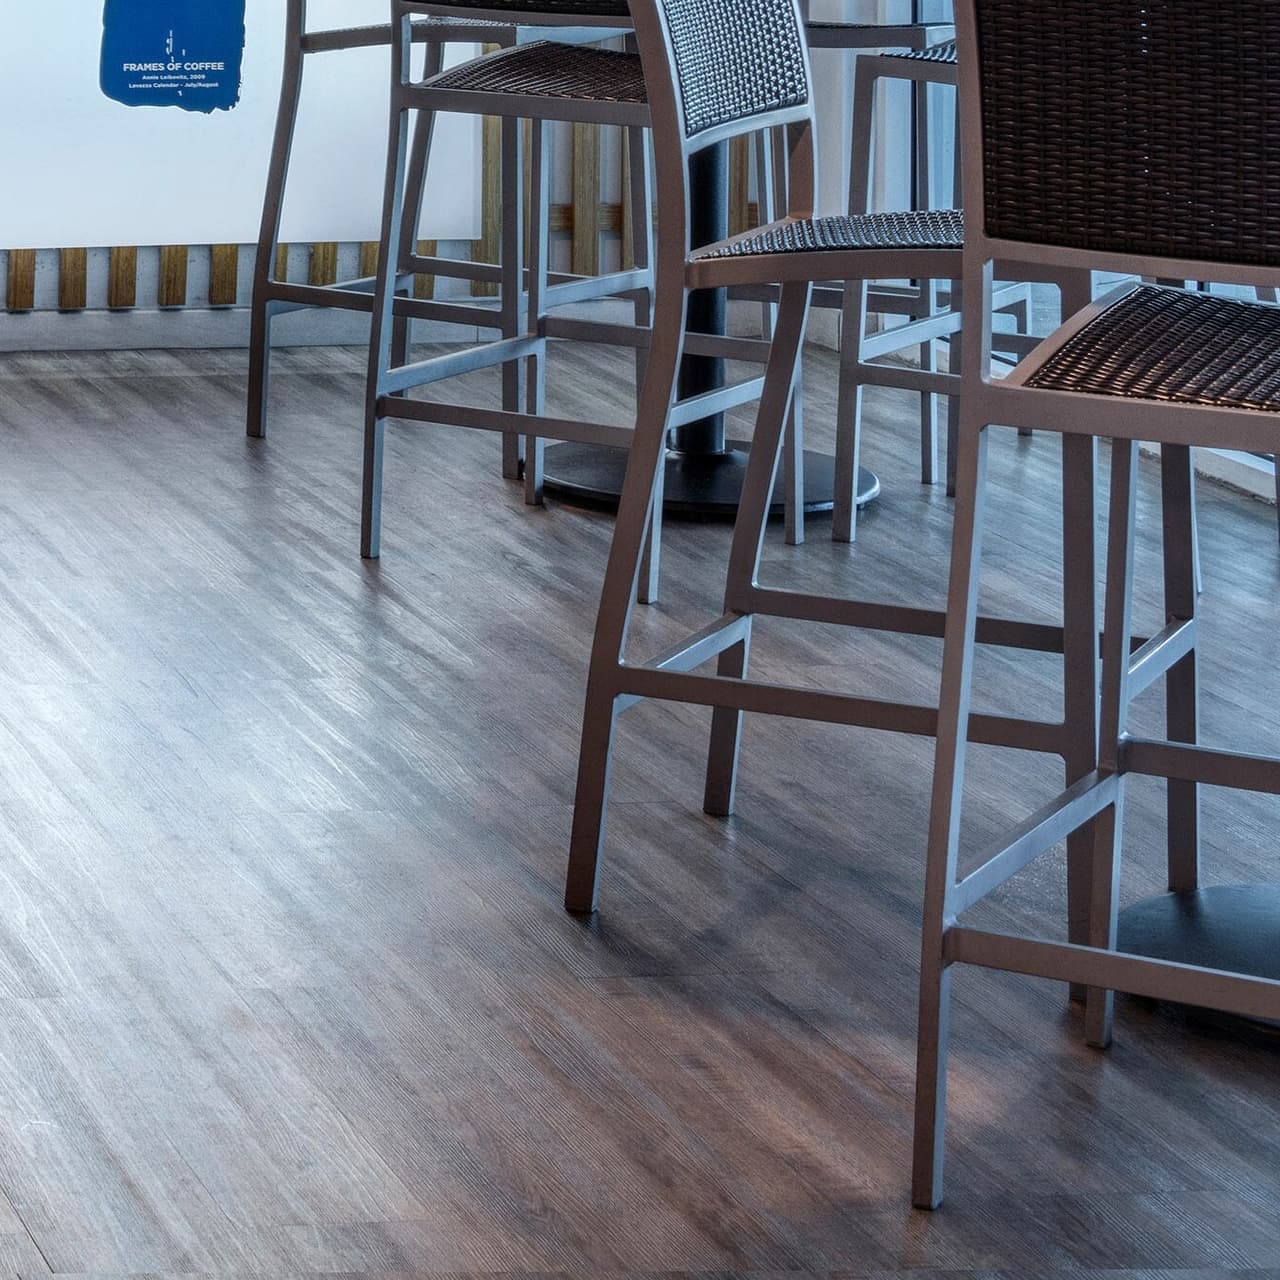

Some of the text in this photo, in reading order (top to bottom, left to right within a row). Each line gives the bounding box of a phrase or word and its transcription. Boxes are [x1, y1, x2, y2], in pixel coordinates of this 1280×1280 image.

[122, 61, 225, 72] FRAMES OF COFFEE
